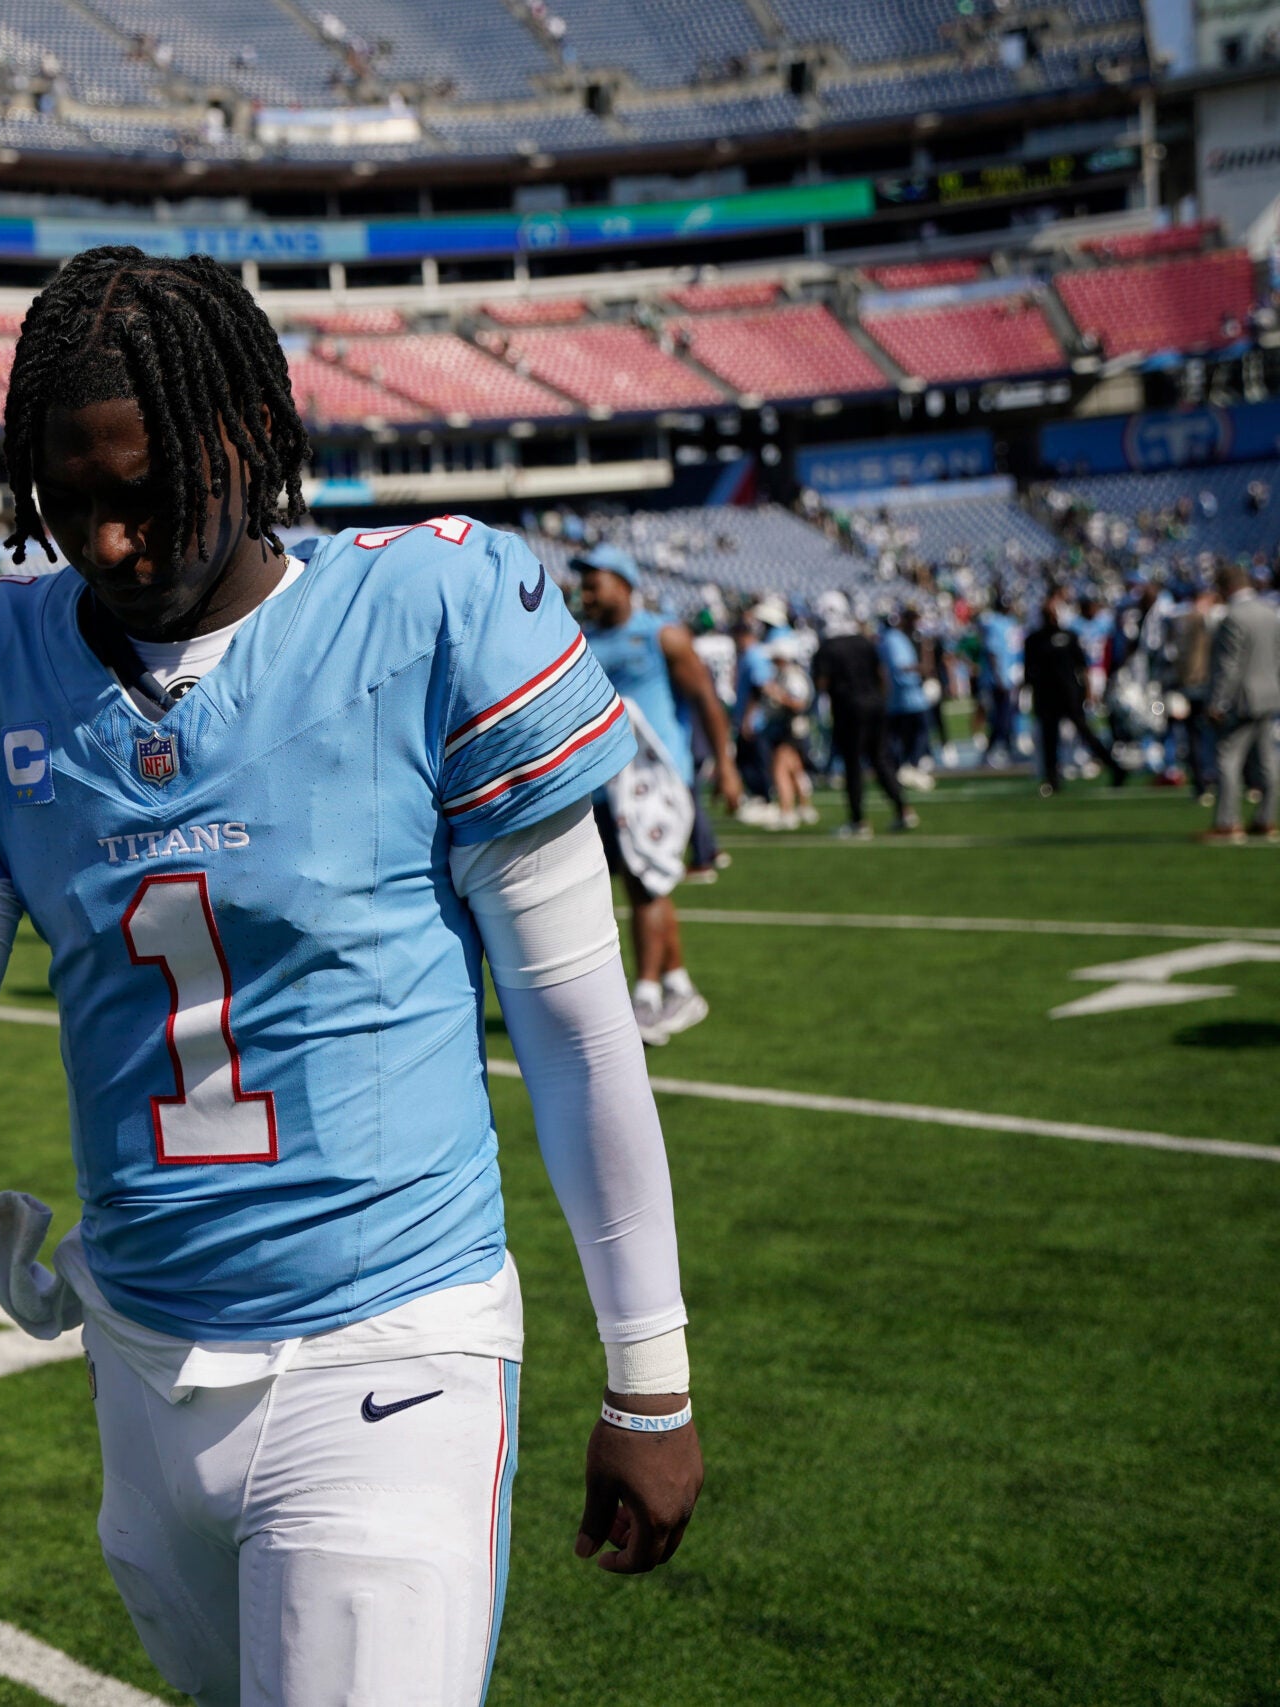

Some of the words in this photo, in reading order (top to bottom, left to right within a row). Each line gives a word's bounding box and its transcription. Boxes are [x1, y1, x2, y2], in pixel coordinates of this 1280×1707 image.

[181, 226, 323, 252] TITANS
[2, 728, 47, 786] C
[144, 755, 172, 777] NFL
[98, 822, 251, 863] TITANS
[120, 871, 279, 1165] 1
[629, 1407, 692, 1431] TITANS
